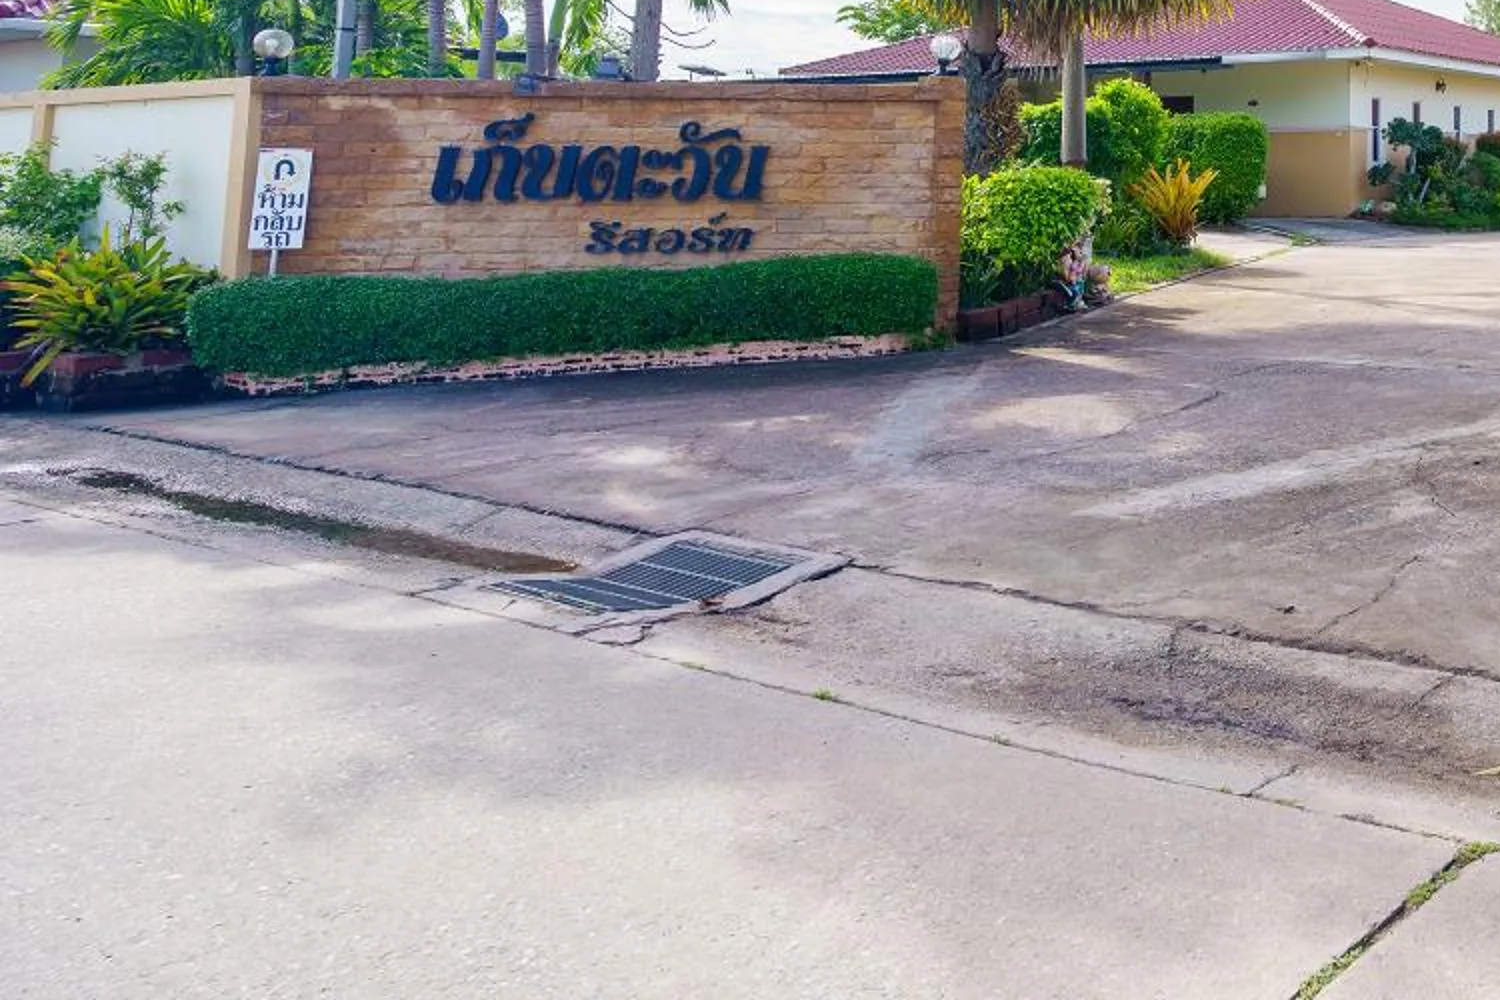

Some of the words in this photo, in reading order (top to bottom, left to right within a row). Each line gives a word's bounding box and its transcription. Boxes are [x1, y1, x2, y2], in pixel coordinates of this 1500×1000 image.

[431, 112, 771, 204] เก็บตะวัน
[257, 183, 305, 209] ห้าม
[253, 208, 303, 231] กลับ
[260, 231, 291, 248] รถ
[584, 212, 755, 254] รีสอร์ท
